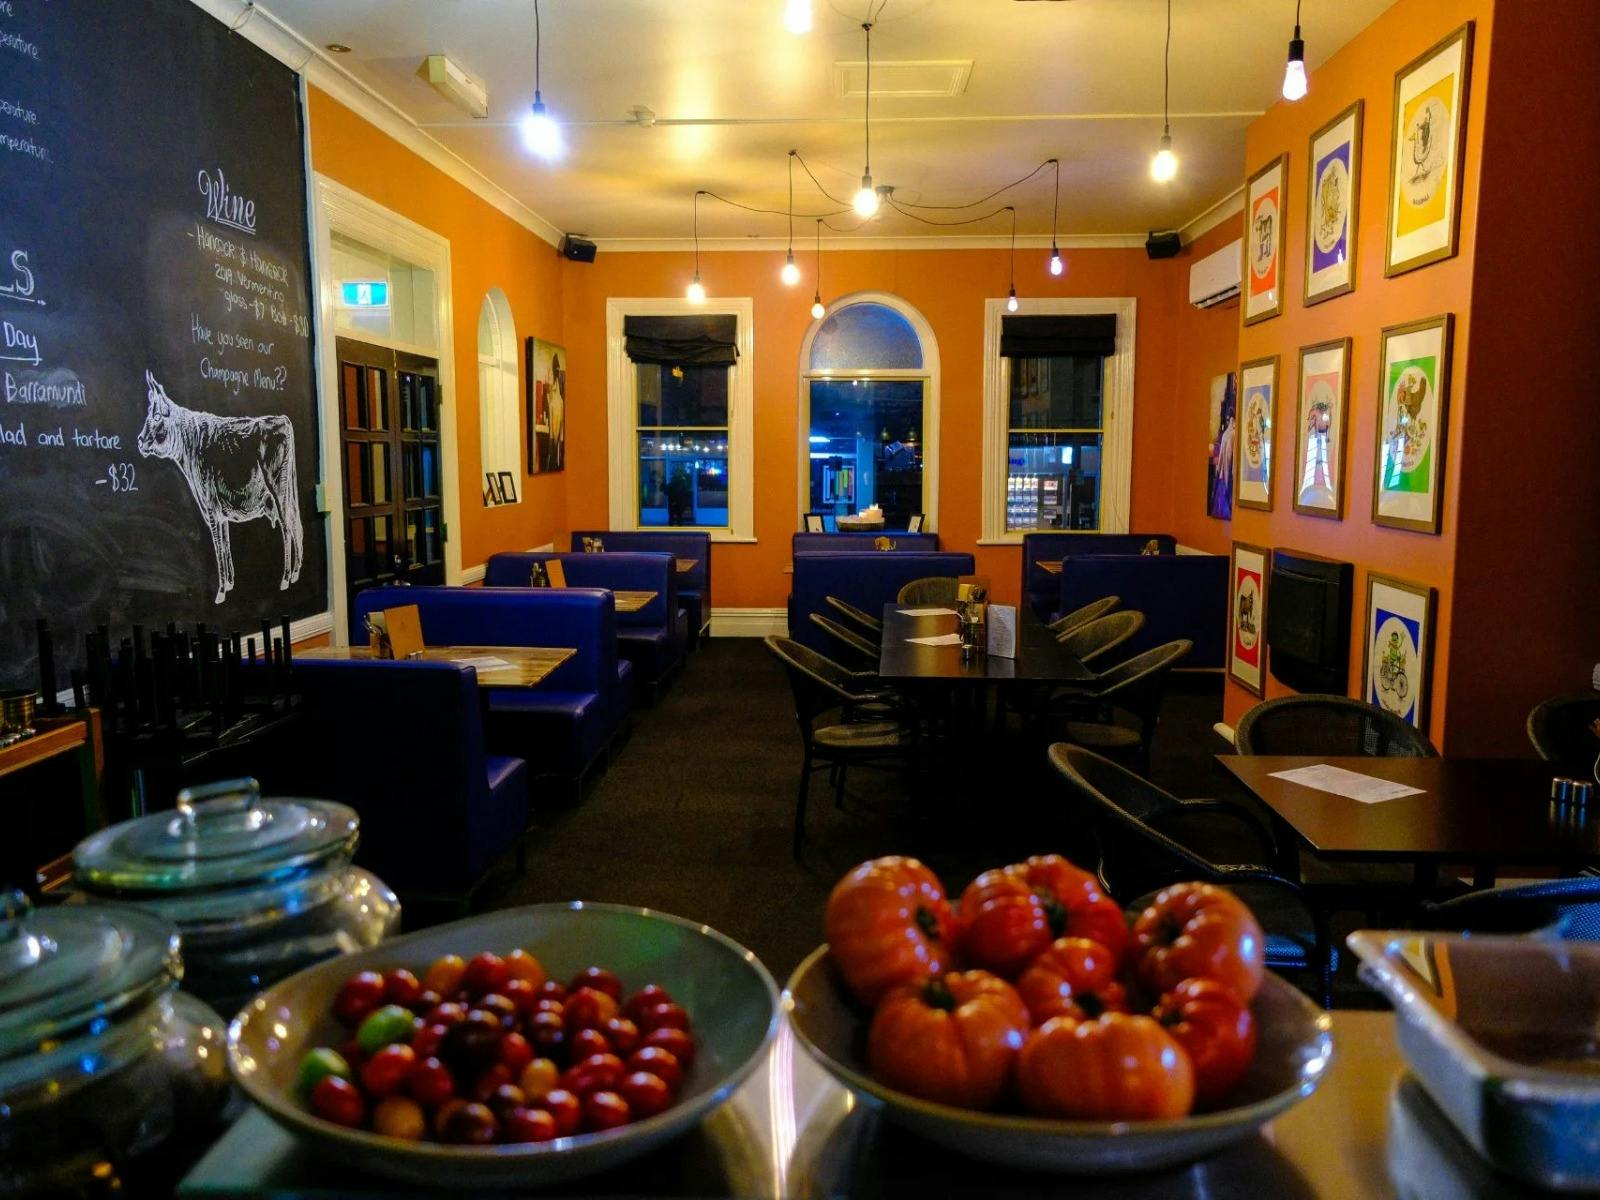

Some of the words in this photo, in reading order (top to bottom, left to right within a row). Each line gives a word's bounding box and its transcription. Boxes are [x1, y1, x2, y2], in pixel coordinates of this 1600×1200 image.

[0, 1, 13, 17] re
[198, 167, 257, 229] Wine
[3, 321, 40, 366] Day
[191, 312, 211, 346] Have
[217, 332, 234, 355] you
[235, 334, 255, 351] seen
[258, 342, 275, 355] our
[5, 372, 87, 407] Barramundi
[200, 357, 250, 396] Champagne
[38, 427, 65, 447] and
[72, 428, 122, 450] tartare
